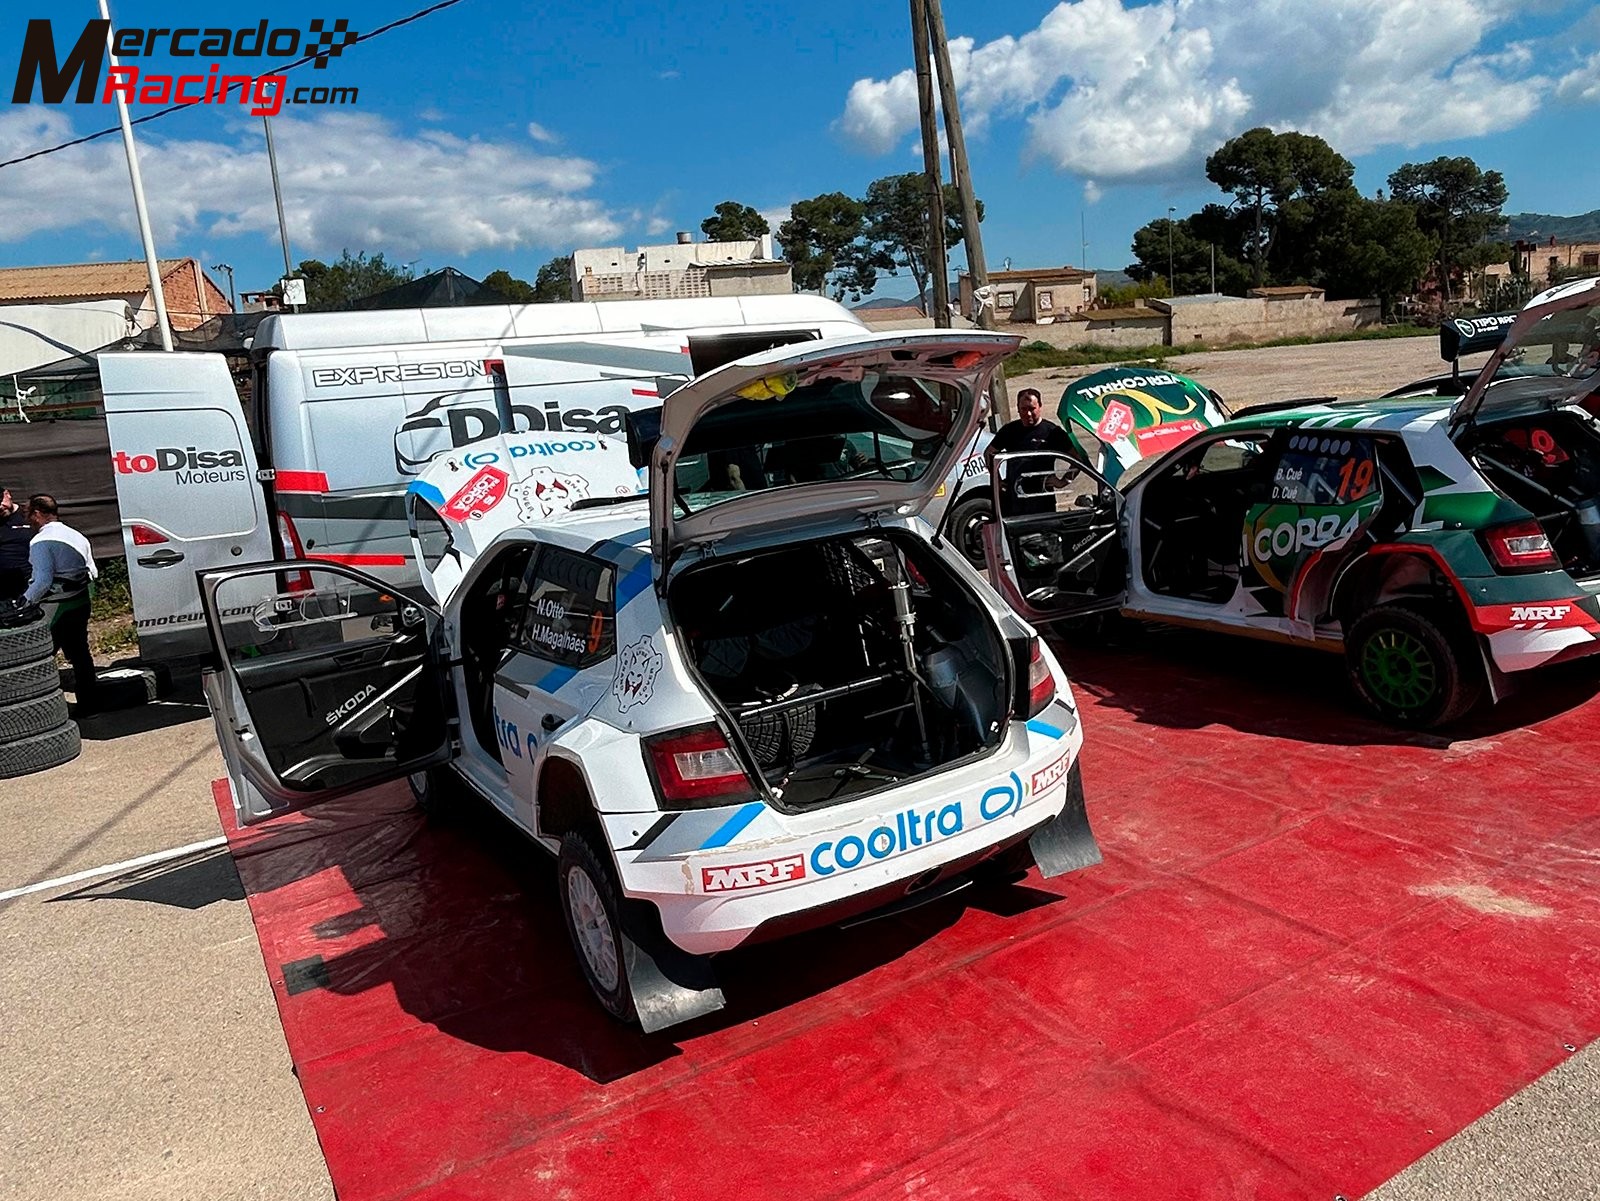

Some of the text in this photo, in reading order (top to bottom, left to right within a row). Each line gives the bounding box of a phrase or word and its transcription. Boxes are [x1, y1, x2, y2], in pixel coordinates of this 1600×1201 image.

[1471, 317, 1498, 328] TIPO
[313, 359, 487, 388] EXPRESION
[509, 440, 597, 459] cooltra
[176, 469, 246, 486] Moteurs
[1286, 467, 1303, 481] Cué
[1339, 457, 1374, 500] 19
[453, 473, 498, 510] LORCA
[1281, 486, 1298, 499] Cué
[1510, 606, 1570, 621] MRF
[588, 610, 604, 653] 9
[325, 683, 377, 727] ŠKODA
[1033, 750, 1070, 793] MRF
[704, 802, 963, 892] MRF cooltra
